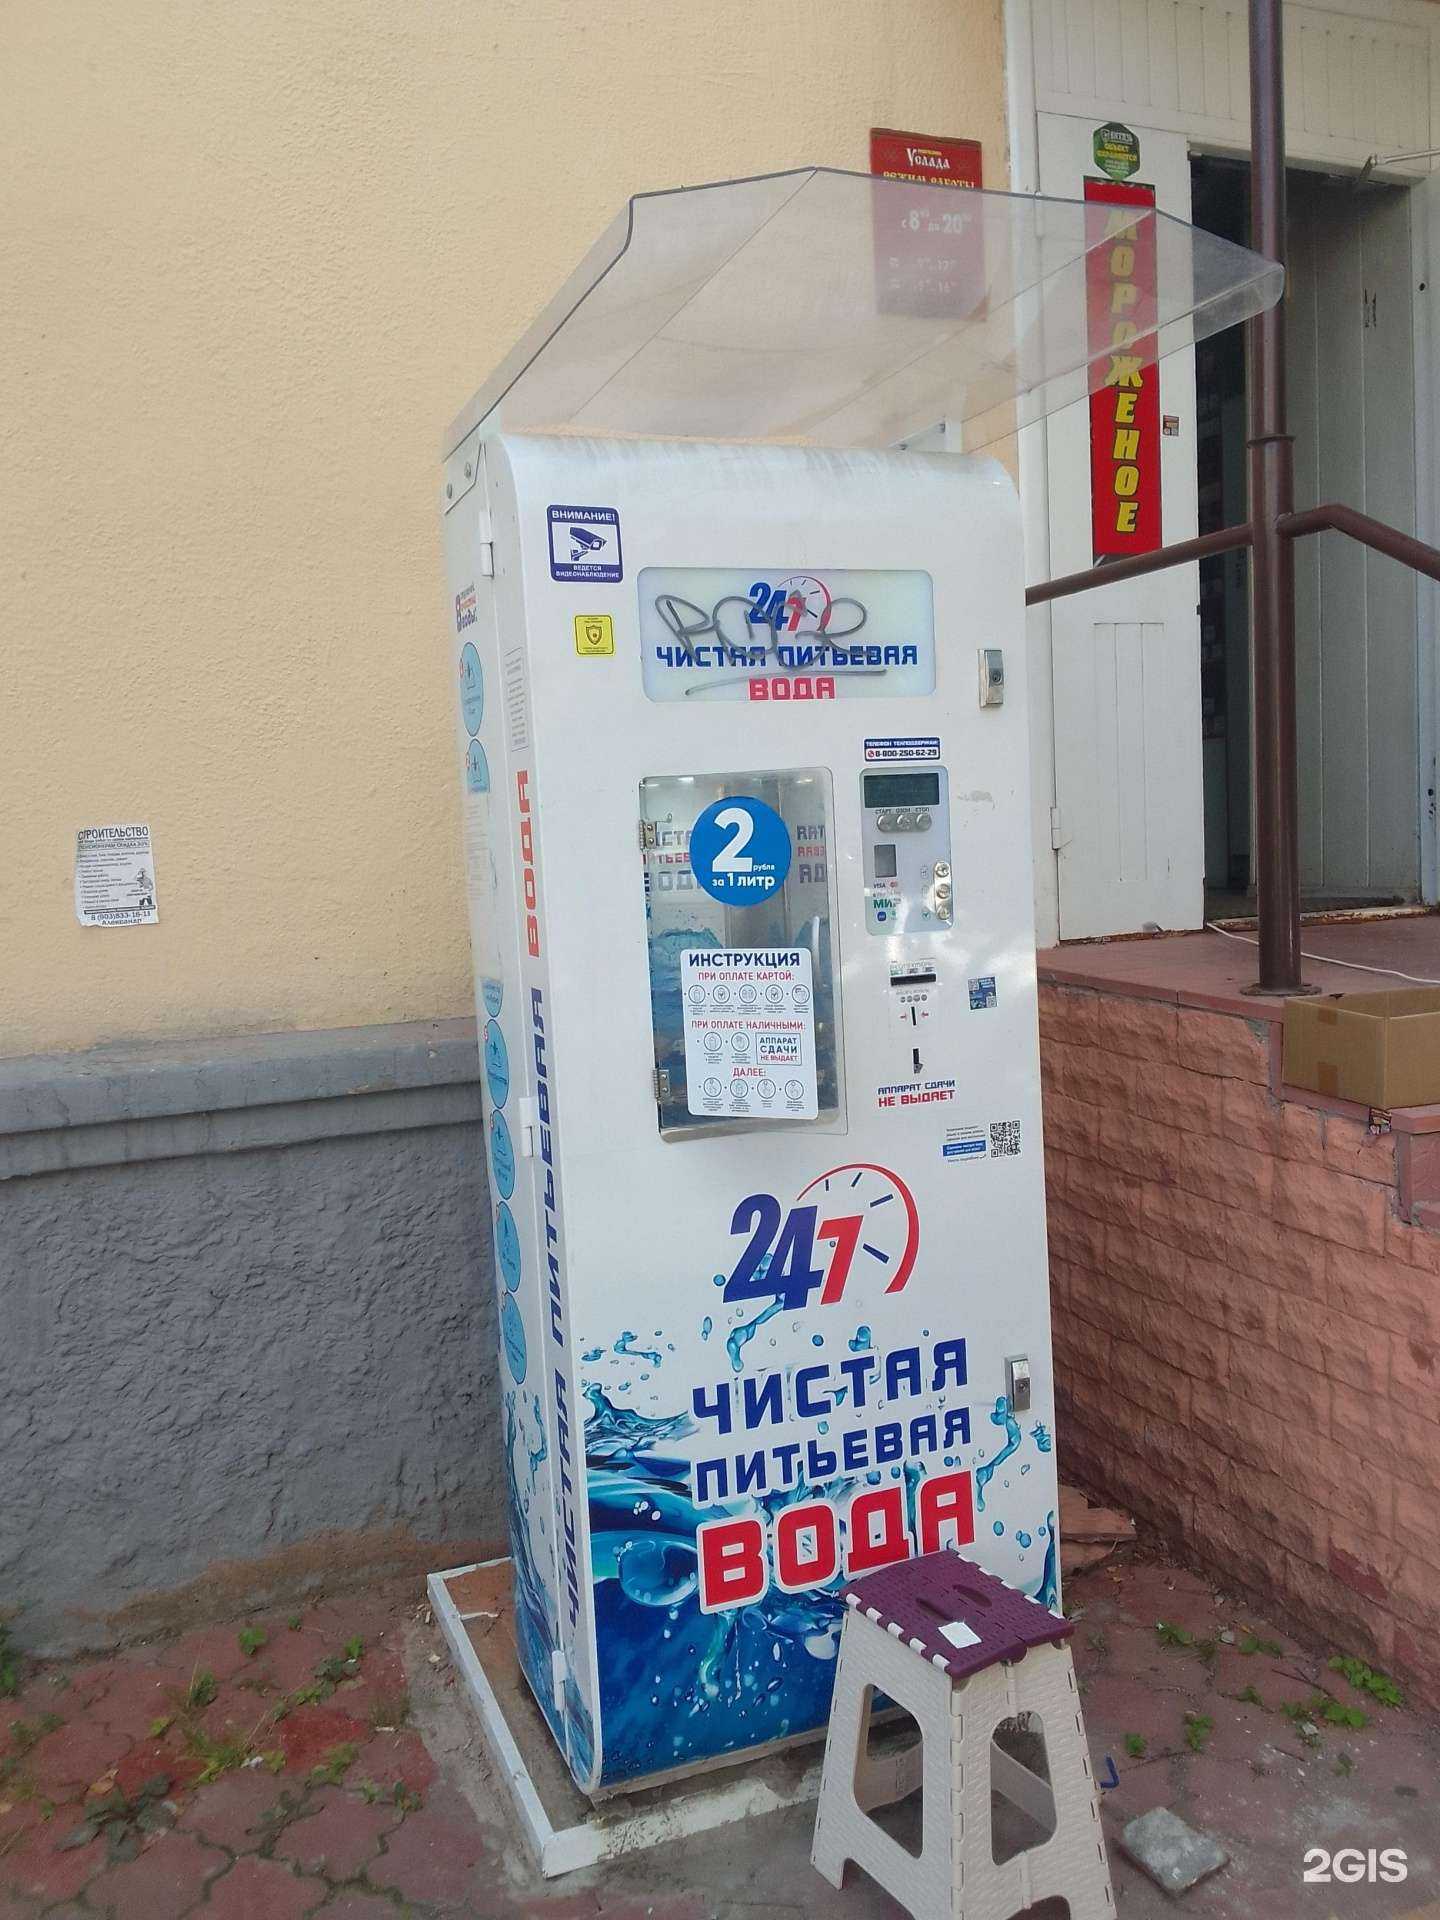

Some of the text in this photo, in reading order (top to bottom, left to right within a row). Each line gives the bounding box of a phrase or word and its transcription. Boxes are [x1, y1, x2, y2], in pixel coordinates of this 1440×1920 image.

[1104, 208, 1143, 533] МОРОЖЕНОЕ
[552, 510, 616, 521] ВНИМАНИЕ!
[656, 645, 918, 667] ЧИСТАЯ ПИТЬЕВАЯ
[749, 677, 835, 700] ВОДА
[712, 807, 775, 872] 2 рубля
[516, 770, 540, 958] ВОДА
[727, 873, 734, 886] 1
[737, 876, 775, 890] литр
[873, 899, 896, 908] МИ
[689, 952, 800, 968] ИНСТРУКЦИЯ
[698, 970, 795, 981] ПРИ ОПЛАТЕ КАРТОЙ:
[691, 1020, 806, 1030] ПРИ ОПЛАТЕ НАЛИЧНЫМИ:
[760, 1045, 798, 1054] СДАЧИ
[733, 1067, 766, 1077] ДАЛЕЕ:
[877, 1079, 956, 1095] АППАРАТ СДАЧИ
[878, 1089, 956, 1107] НЕ ВЫДАЕТ
[692, 1338, 969, 1434] ЧИСТАЯ
[696, 1407, 972, 1502] ПИТЬЕВАЯ
[705, 1471, 975, 1607] ВОДА
